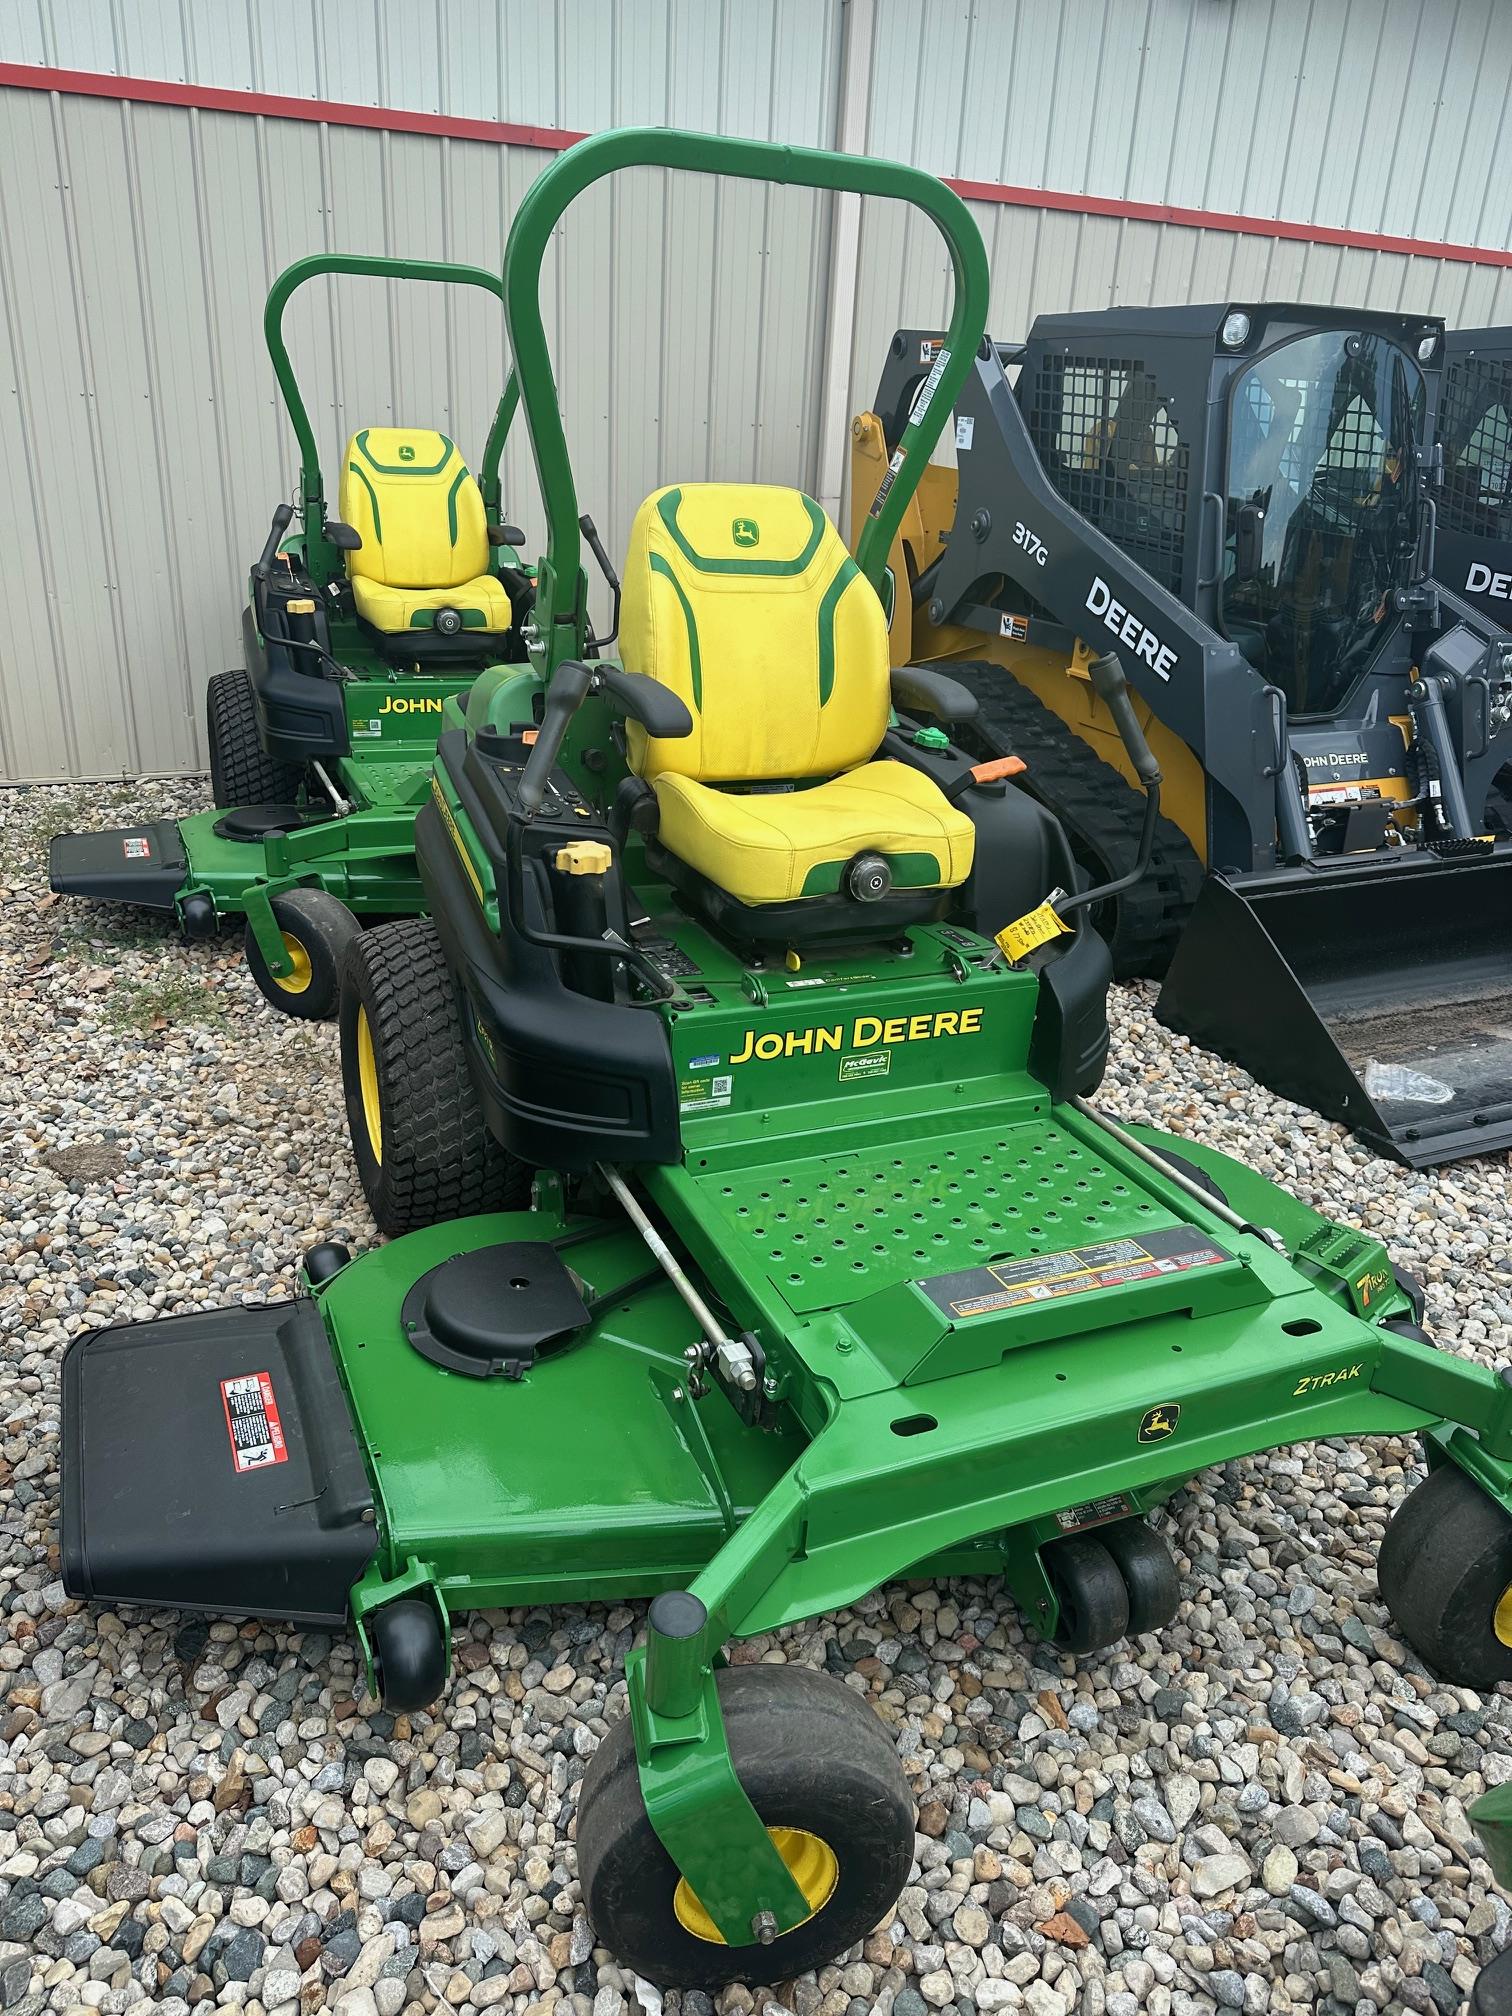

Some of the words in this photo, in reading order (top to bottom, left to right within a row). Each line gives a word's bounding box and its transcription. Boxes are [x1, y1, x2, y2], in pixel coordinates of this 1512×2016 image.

[1011, 520, 1050, 567] 317G
[1465, 562, 1512, 600] DE
[1084, 575, 1180, 683] DEERE
[378, 695, 443, 714] JOHN
[1303, 756, 1328, 768] OHN
[1328, 753, 1369, 766] DEERE
[729, 1024, 843, 1066] JOHN
[852, 1007, 984, 1049] DEERE
[1293, 1362, 1365, 1396] ZTRAK
